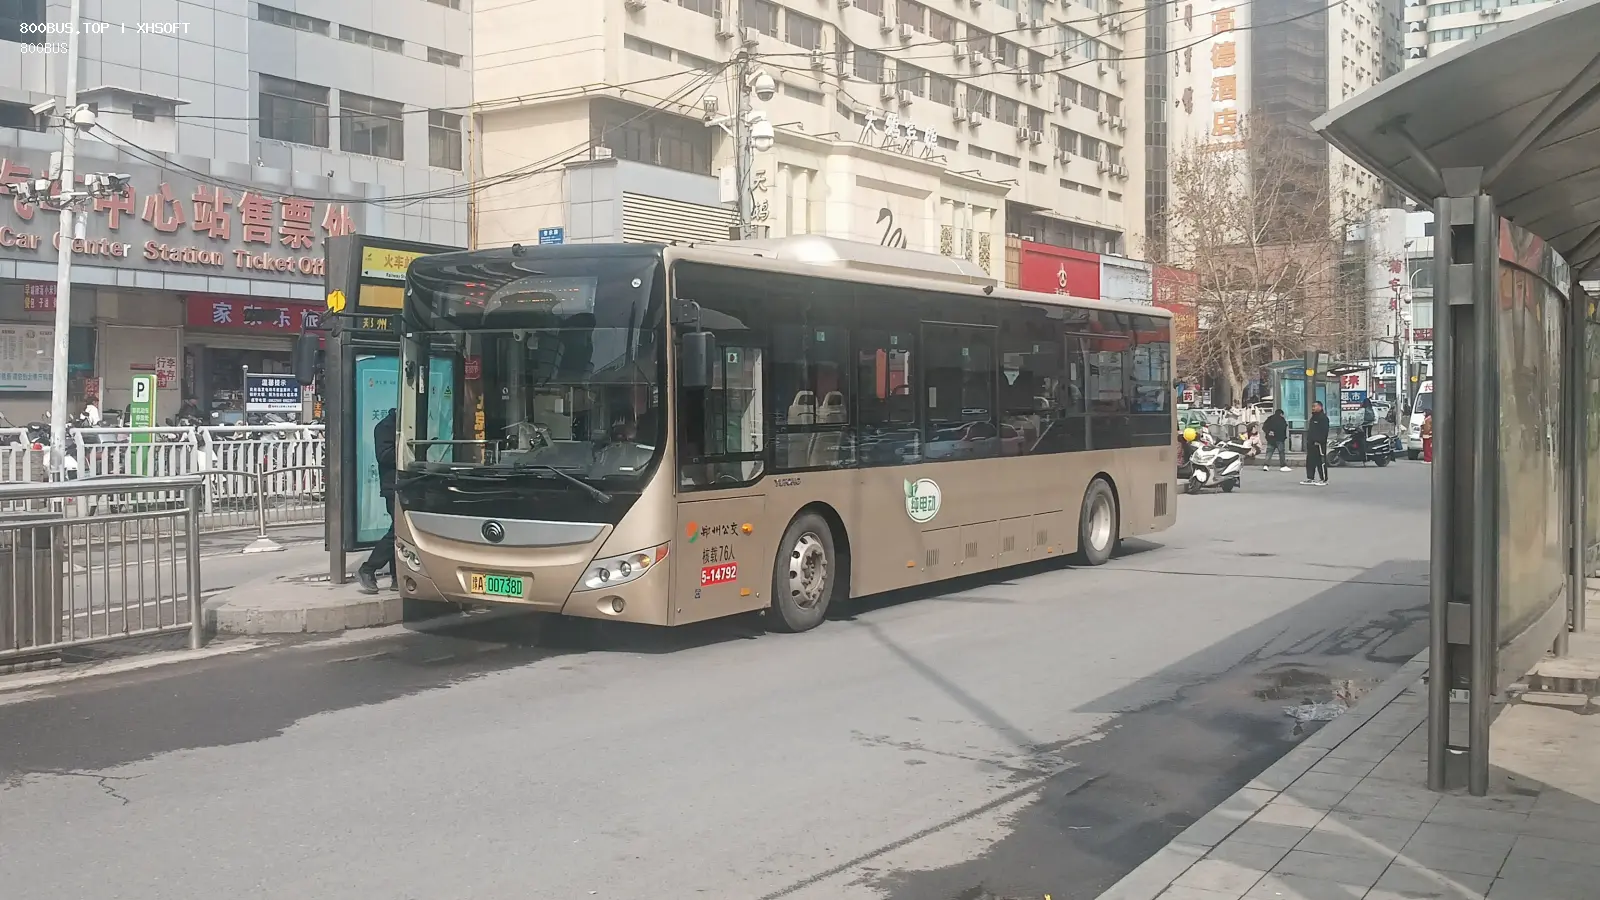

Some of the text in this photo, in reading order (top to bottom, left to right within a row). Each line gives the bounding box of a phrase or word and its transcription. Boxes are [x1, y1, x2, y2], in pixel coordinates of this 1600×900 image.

[0, 225, 42, 249] Car
[143, 240, 224, 266] Station
[233, 248, 296, 273] Ticket
[136, 381, 145, 398] P
[911, 495, 936, 514] 纯电动
[700, 521, 739, 539] 郑州公交
[701, 565, 737, 584] 5-14792
